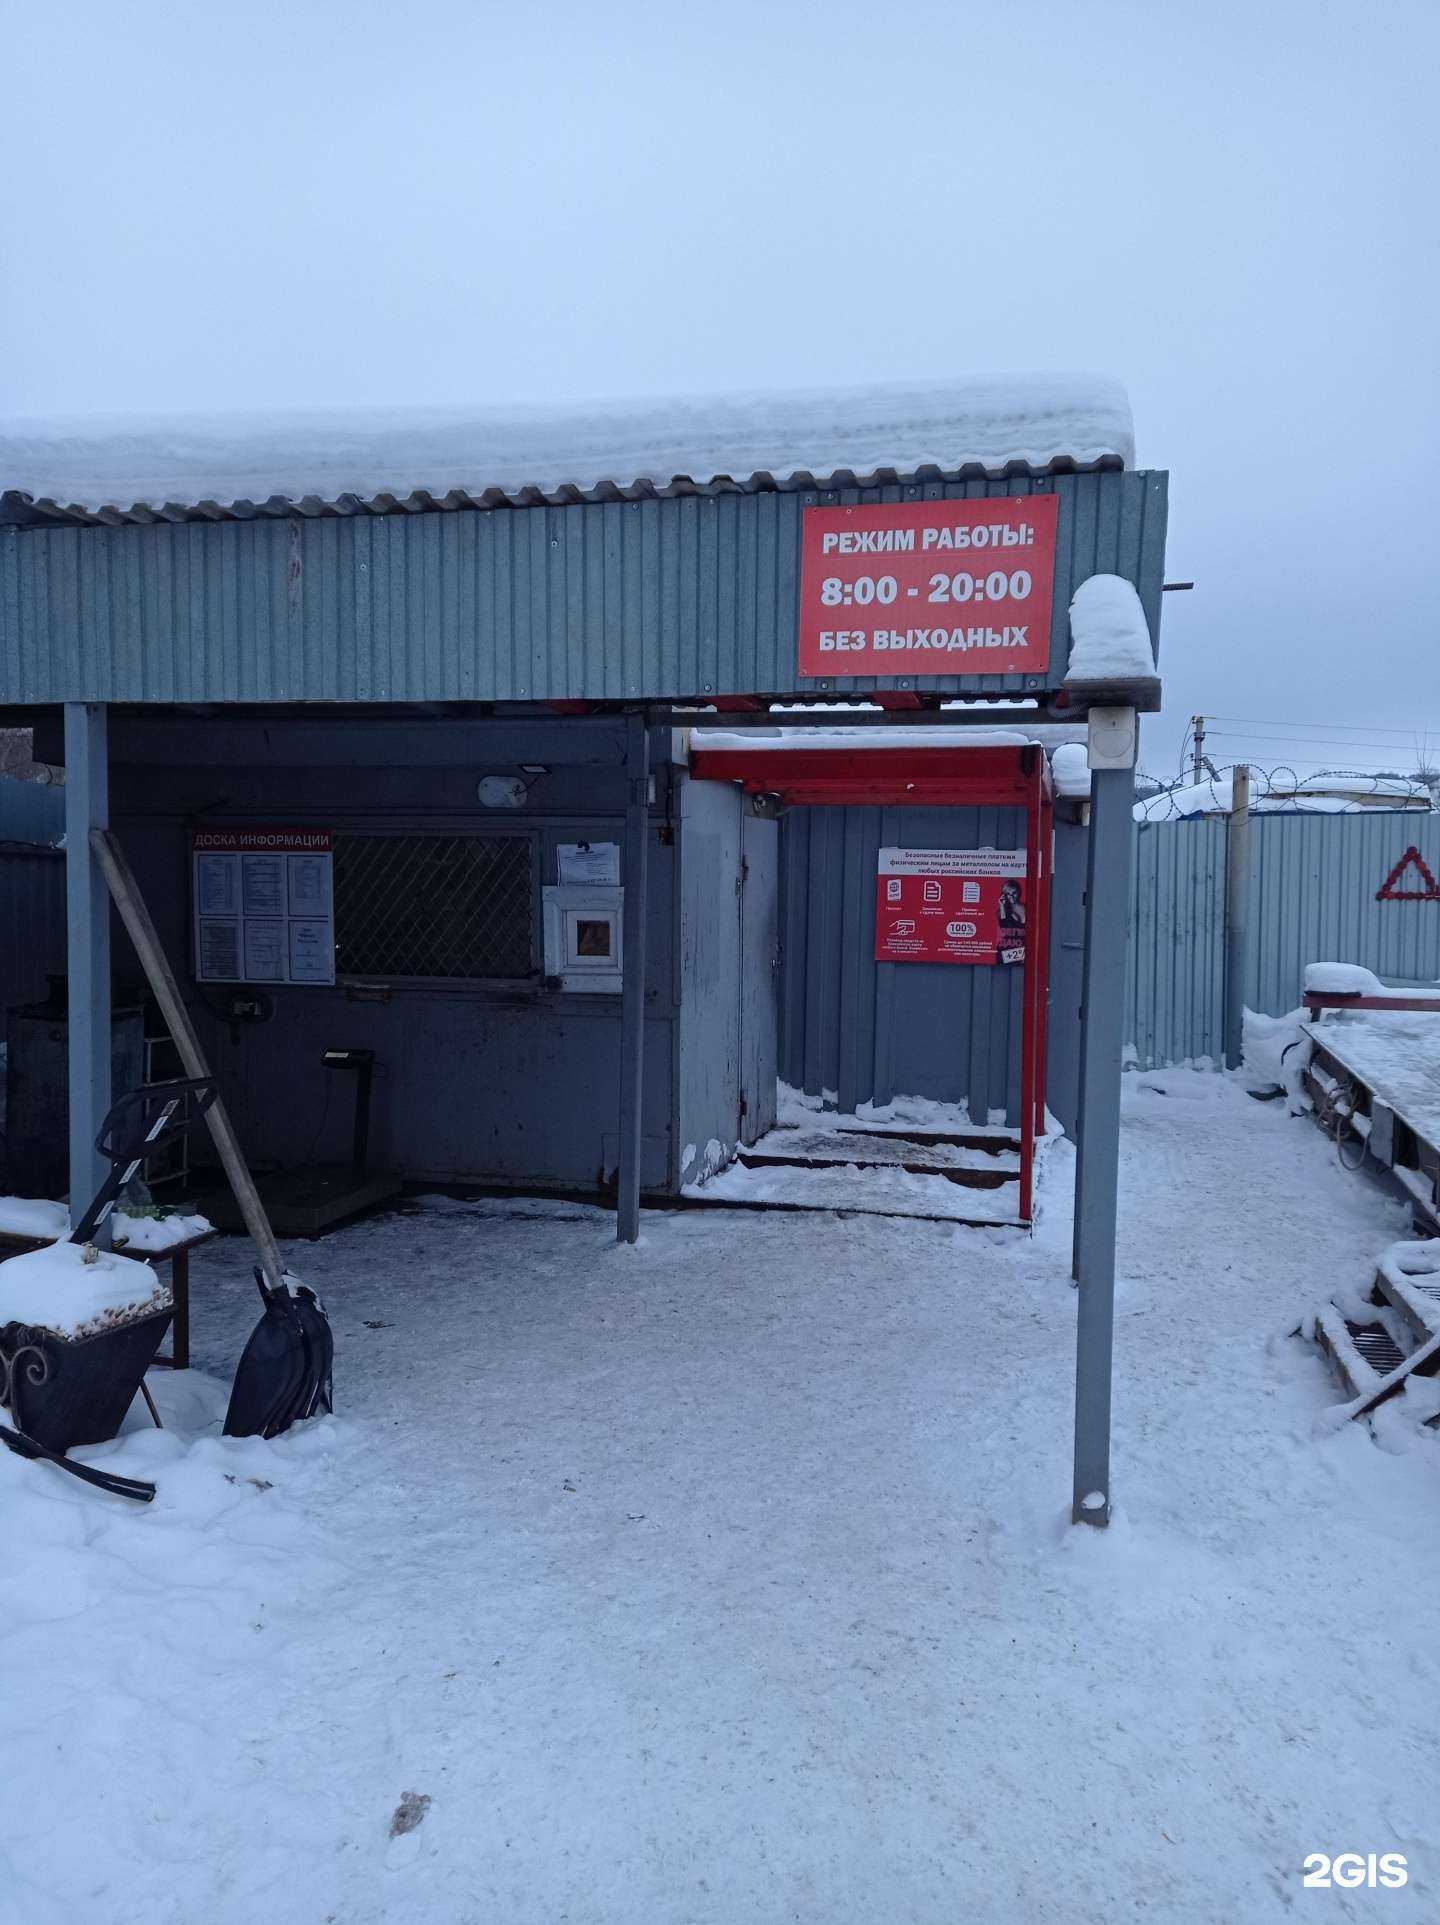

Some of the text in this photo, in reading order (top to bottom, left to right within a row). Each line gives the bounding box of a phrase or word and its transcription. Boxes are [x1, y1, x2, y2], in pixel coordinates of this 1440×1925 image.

[822, 523, 1035, 554] РЕЖИМ РАБОТЫ:
[820, 570, 1032, 606] 8:00 - 20:00
[819, 626, 1029, 652] БЕЗ ВЫХОДНЫХ
[195, 834, 330, 848] ДОСКА ИНФОРМАЦИИ
[905, 851, 943, 859] Безопасные
[944, 852, 987, 860] безналичные
[889, 859, 929, 867] физическим
[930, 860, 951, 868] лицам
[917, 867, 940, 875] любых
[941, 868, 978, 876] российских
[950, 923, 975, 932] 100%
